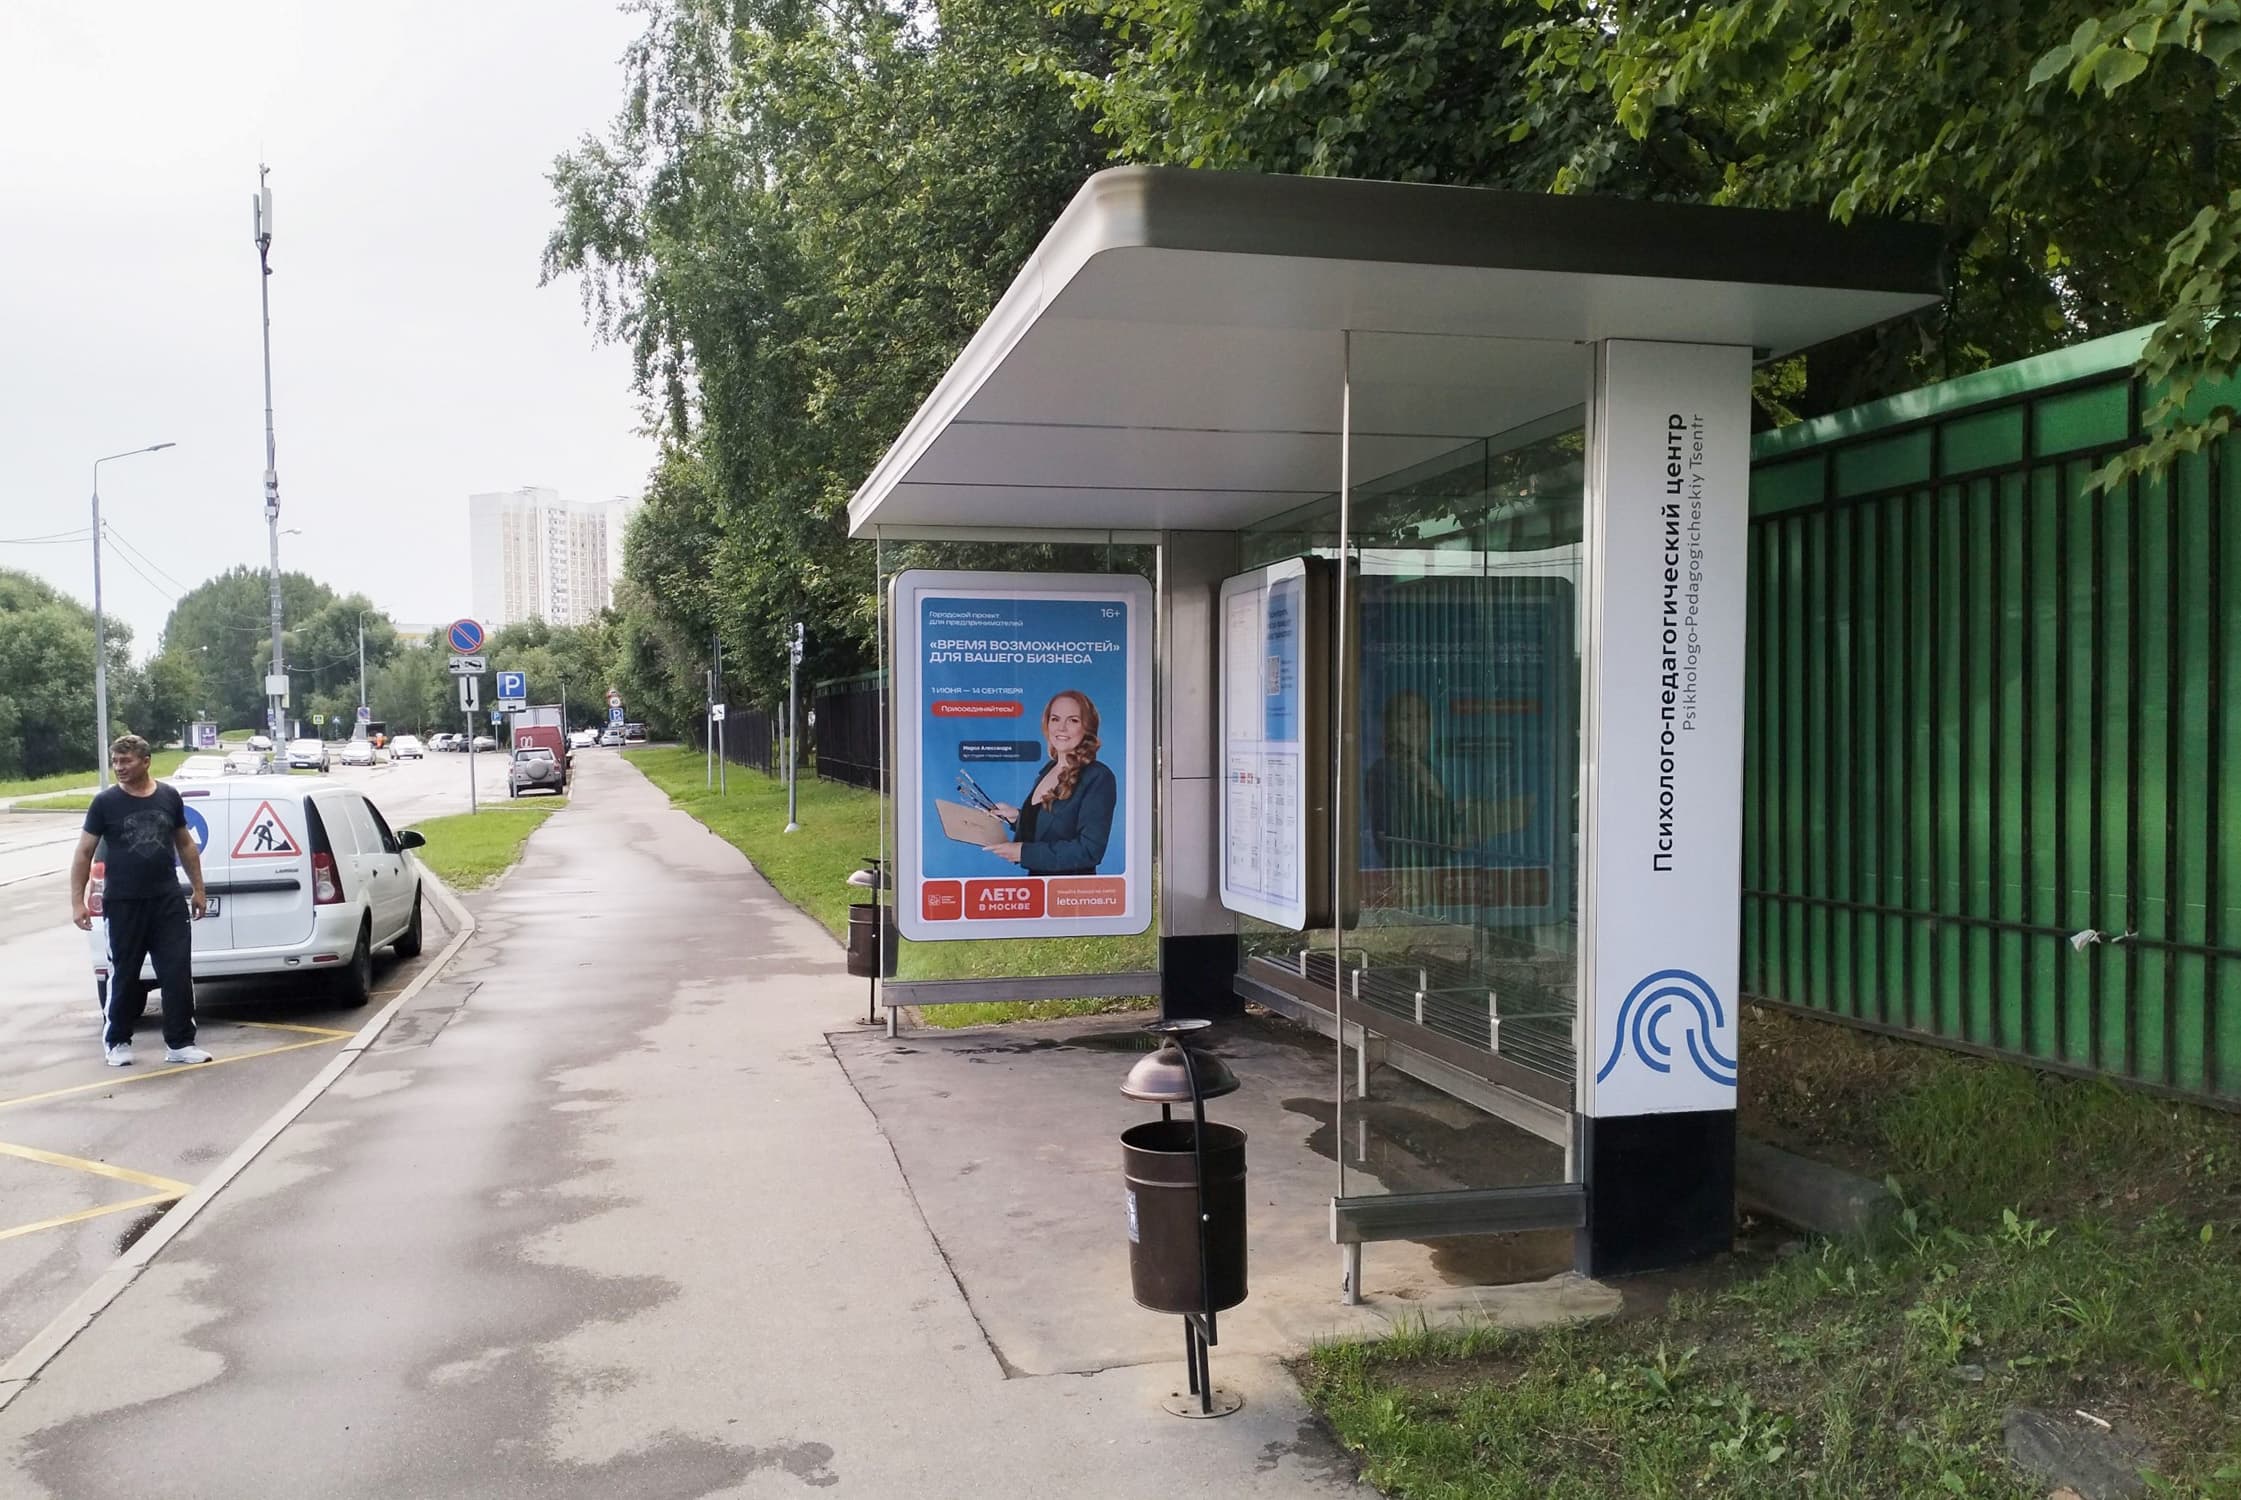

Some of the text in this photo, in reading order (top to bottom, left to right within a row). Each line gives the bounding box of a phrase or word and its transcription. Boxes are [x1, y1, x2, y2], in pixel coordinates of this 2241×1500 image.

[1682, 413, 1705, 731] Psikhologo-Pedagogicheskiy Tsentr
[929, 610, 1000, 620] Городской проект
[1100, 608, 1121, 618] 16+
[946, 619, 1024, 627] предпринимателей
[929, 639, 1120, 652] «ВРЕМЯ ВОЗМОЖНОСТЕЙ»
[1653, 413, 1688, 872] Психолого-педагогический центр
[929, 652, 1093, 664] ДЛЯ ВАШЕГО БИЗНЕСА
[505, 675, 520, 695] P
[981, 687, 1024, 695] СЕНТЯБРЯ
[940, 705, 1015, 713] Присоединяйтесь!
[980, 887, 1031, 901] ЛЕТО
[1056, 896, 1117, 906] leto.mos.ru
[979, 902, 1031, 912] В МОСКВЕ
